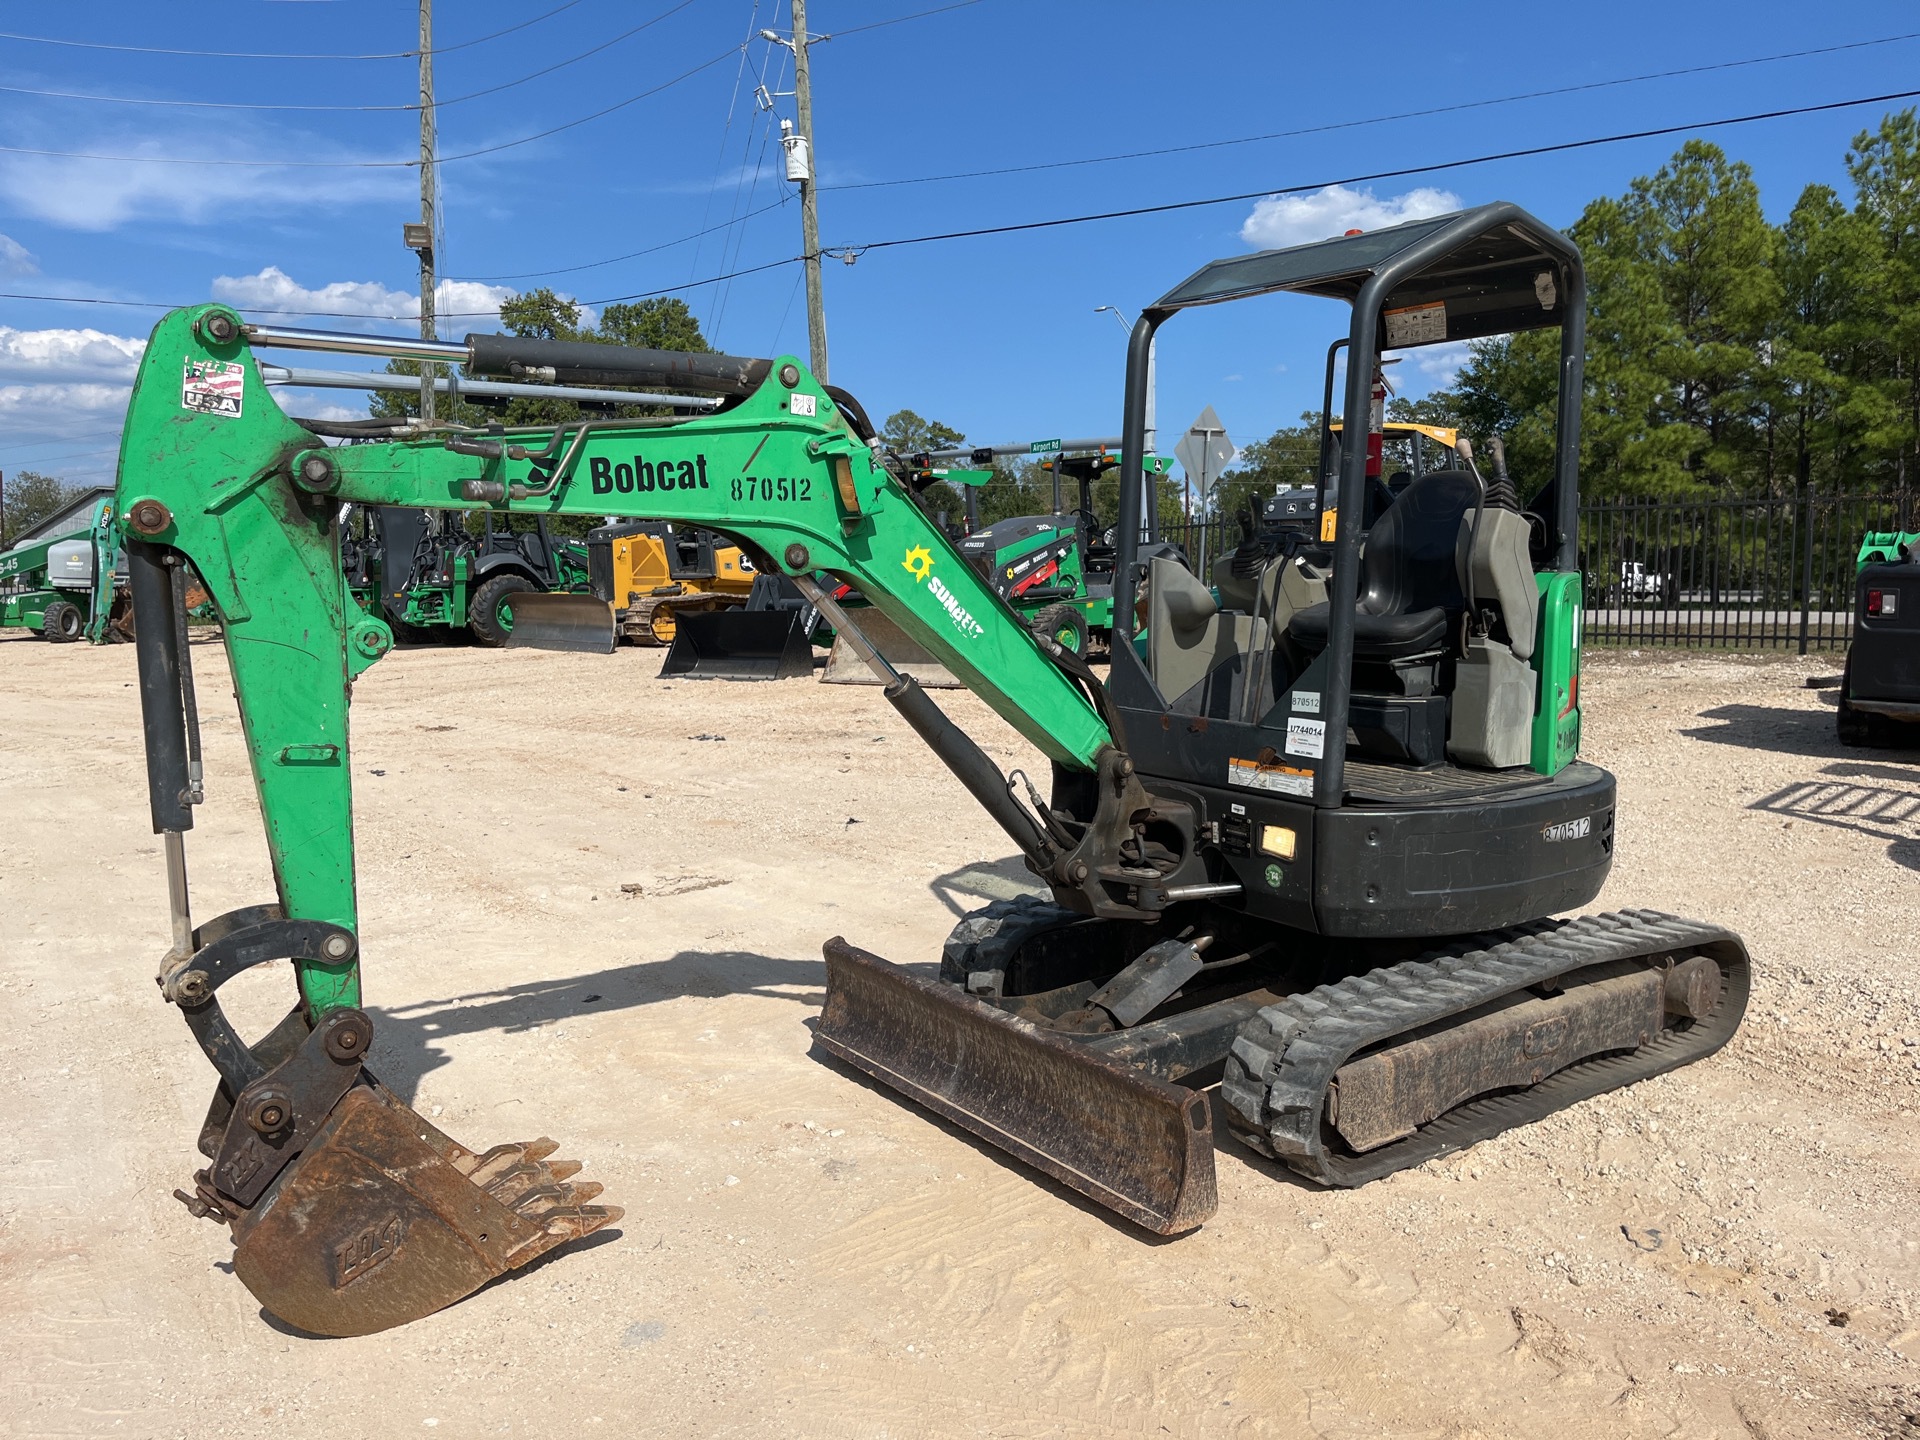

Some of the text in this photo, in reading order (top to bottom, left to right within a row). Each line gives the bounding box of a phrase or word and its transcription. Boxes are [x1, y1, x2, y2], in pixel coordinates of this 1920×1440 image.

[187, 392, 237, 412] USA
[1033, 440, 1059, 452] Airport Rd
[589, 454, 709, 495] Bobcat
[731, 477, 812, 501] 870512
[1292, 697, 1319, 708] 870512
[1290, 725, 1322, 736] U744014
[1544, 818, 1590, 841] 870512
